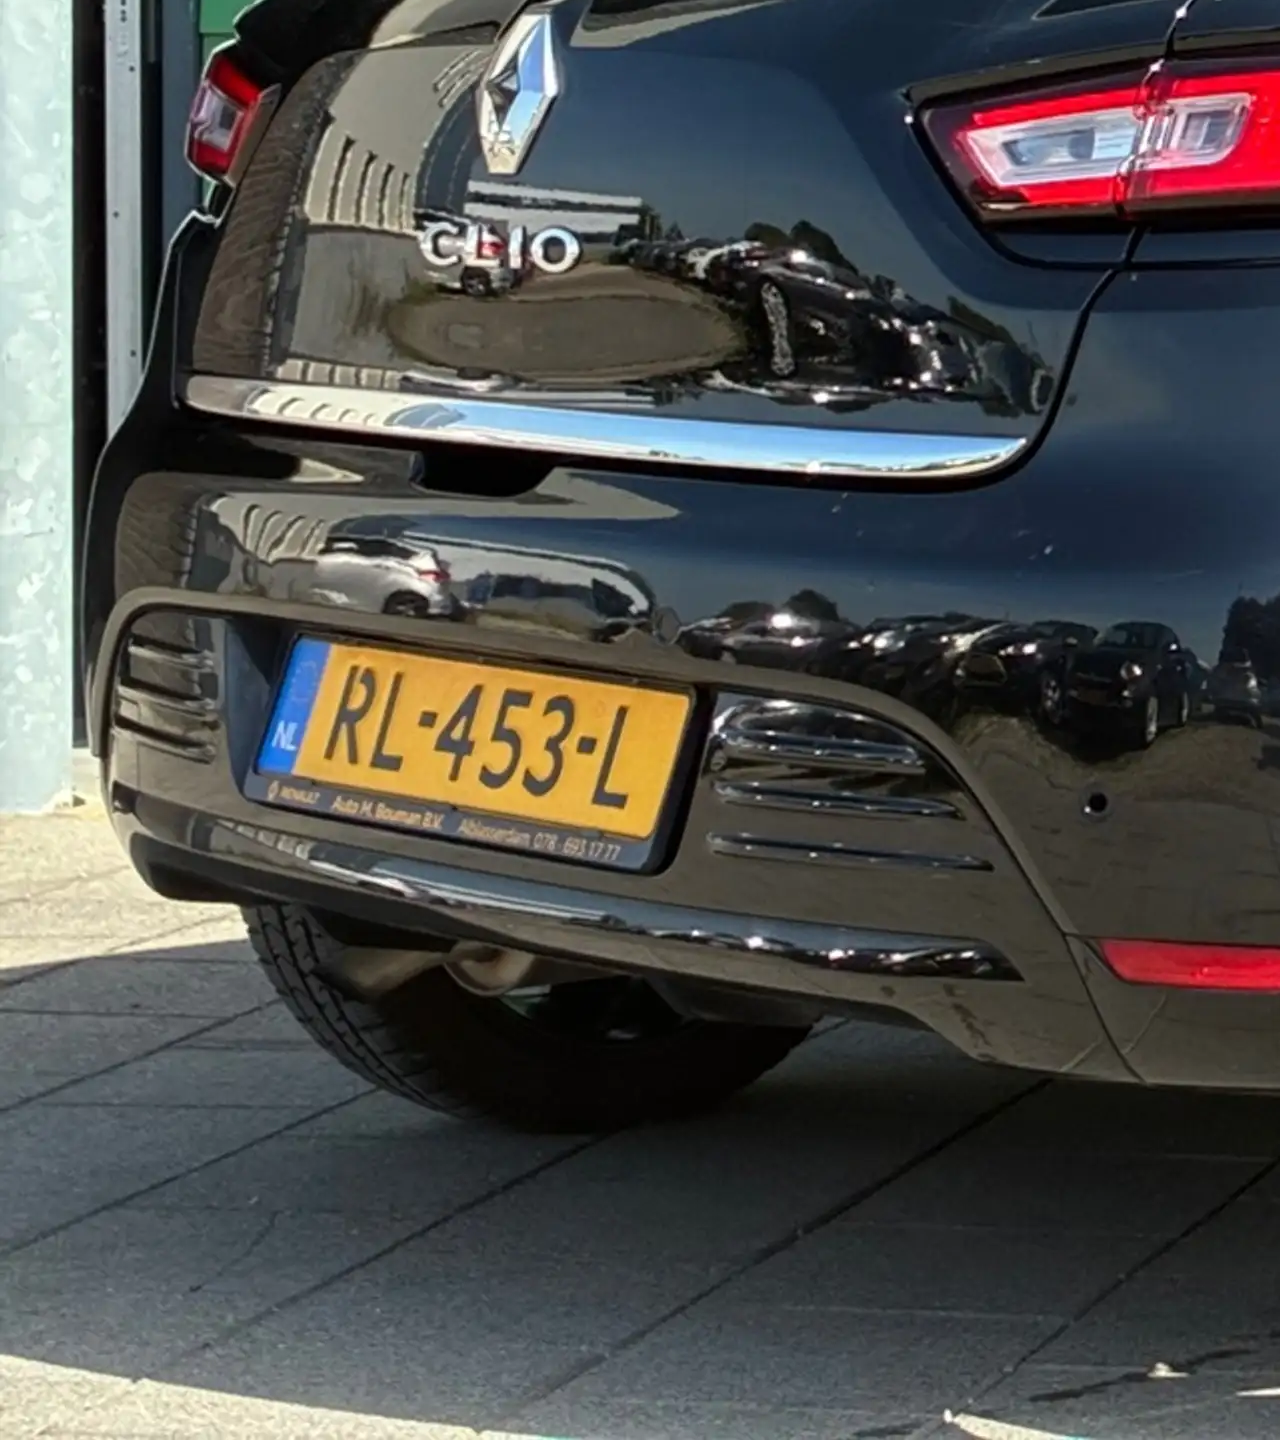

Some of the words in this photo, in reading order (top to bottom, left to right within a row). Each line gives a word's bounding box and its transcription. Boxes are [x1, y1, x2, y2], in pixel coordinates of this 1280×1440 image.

[420, 221, 581, 274] CLIO
[271, 720, 298, 750] NL
[324, 665, 629, 808] RL-453-L
[330, 795, 359, 814] Auto
